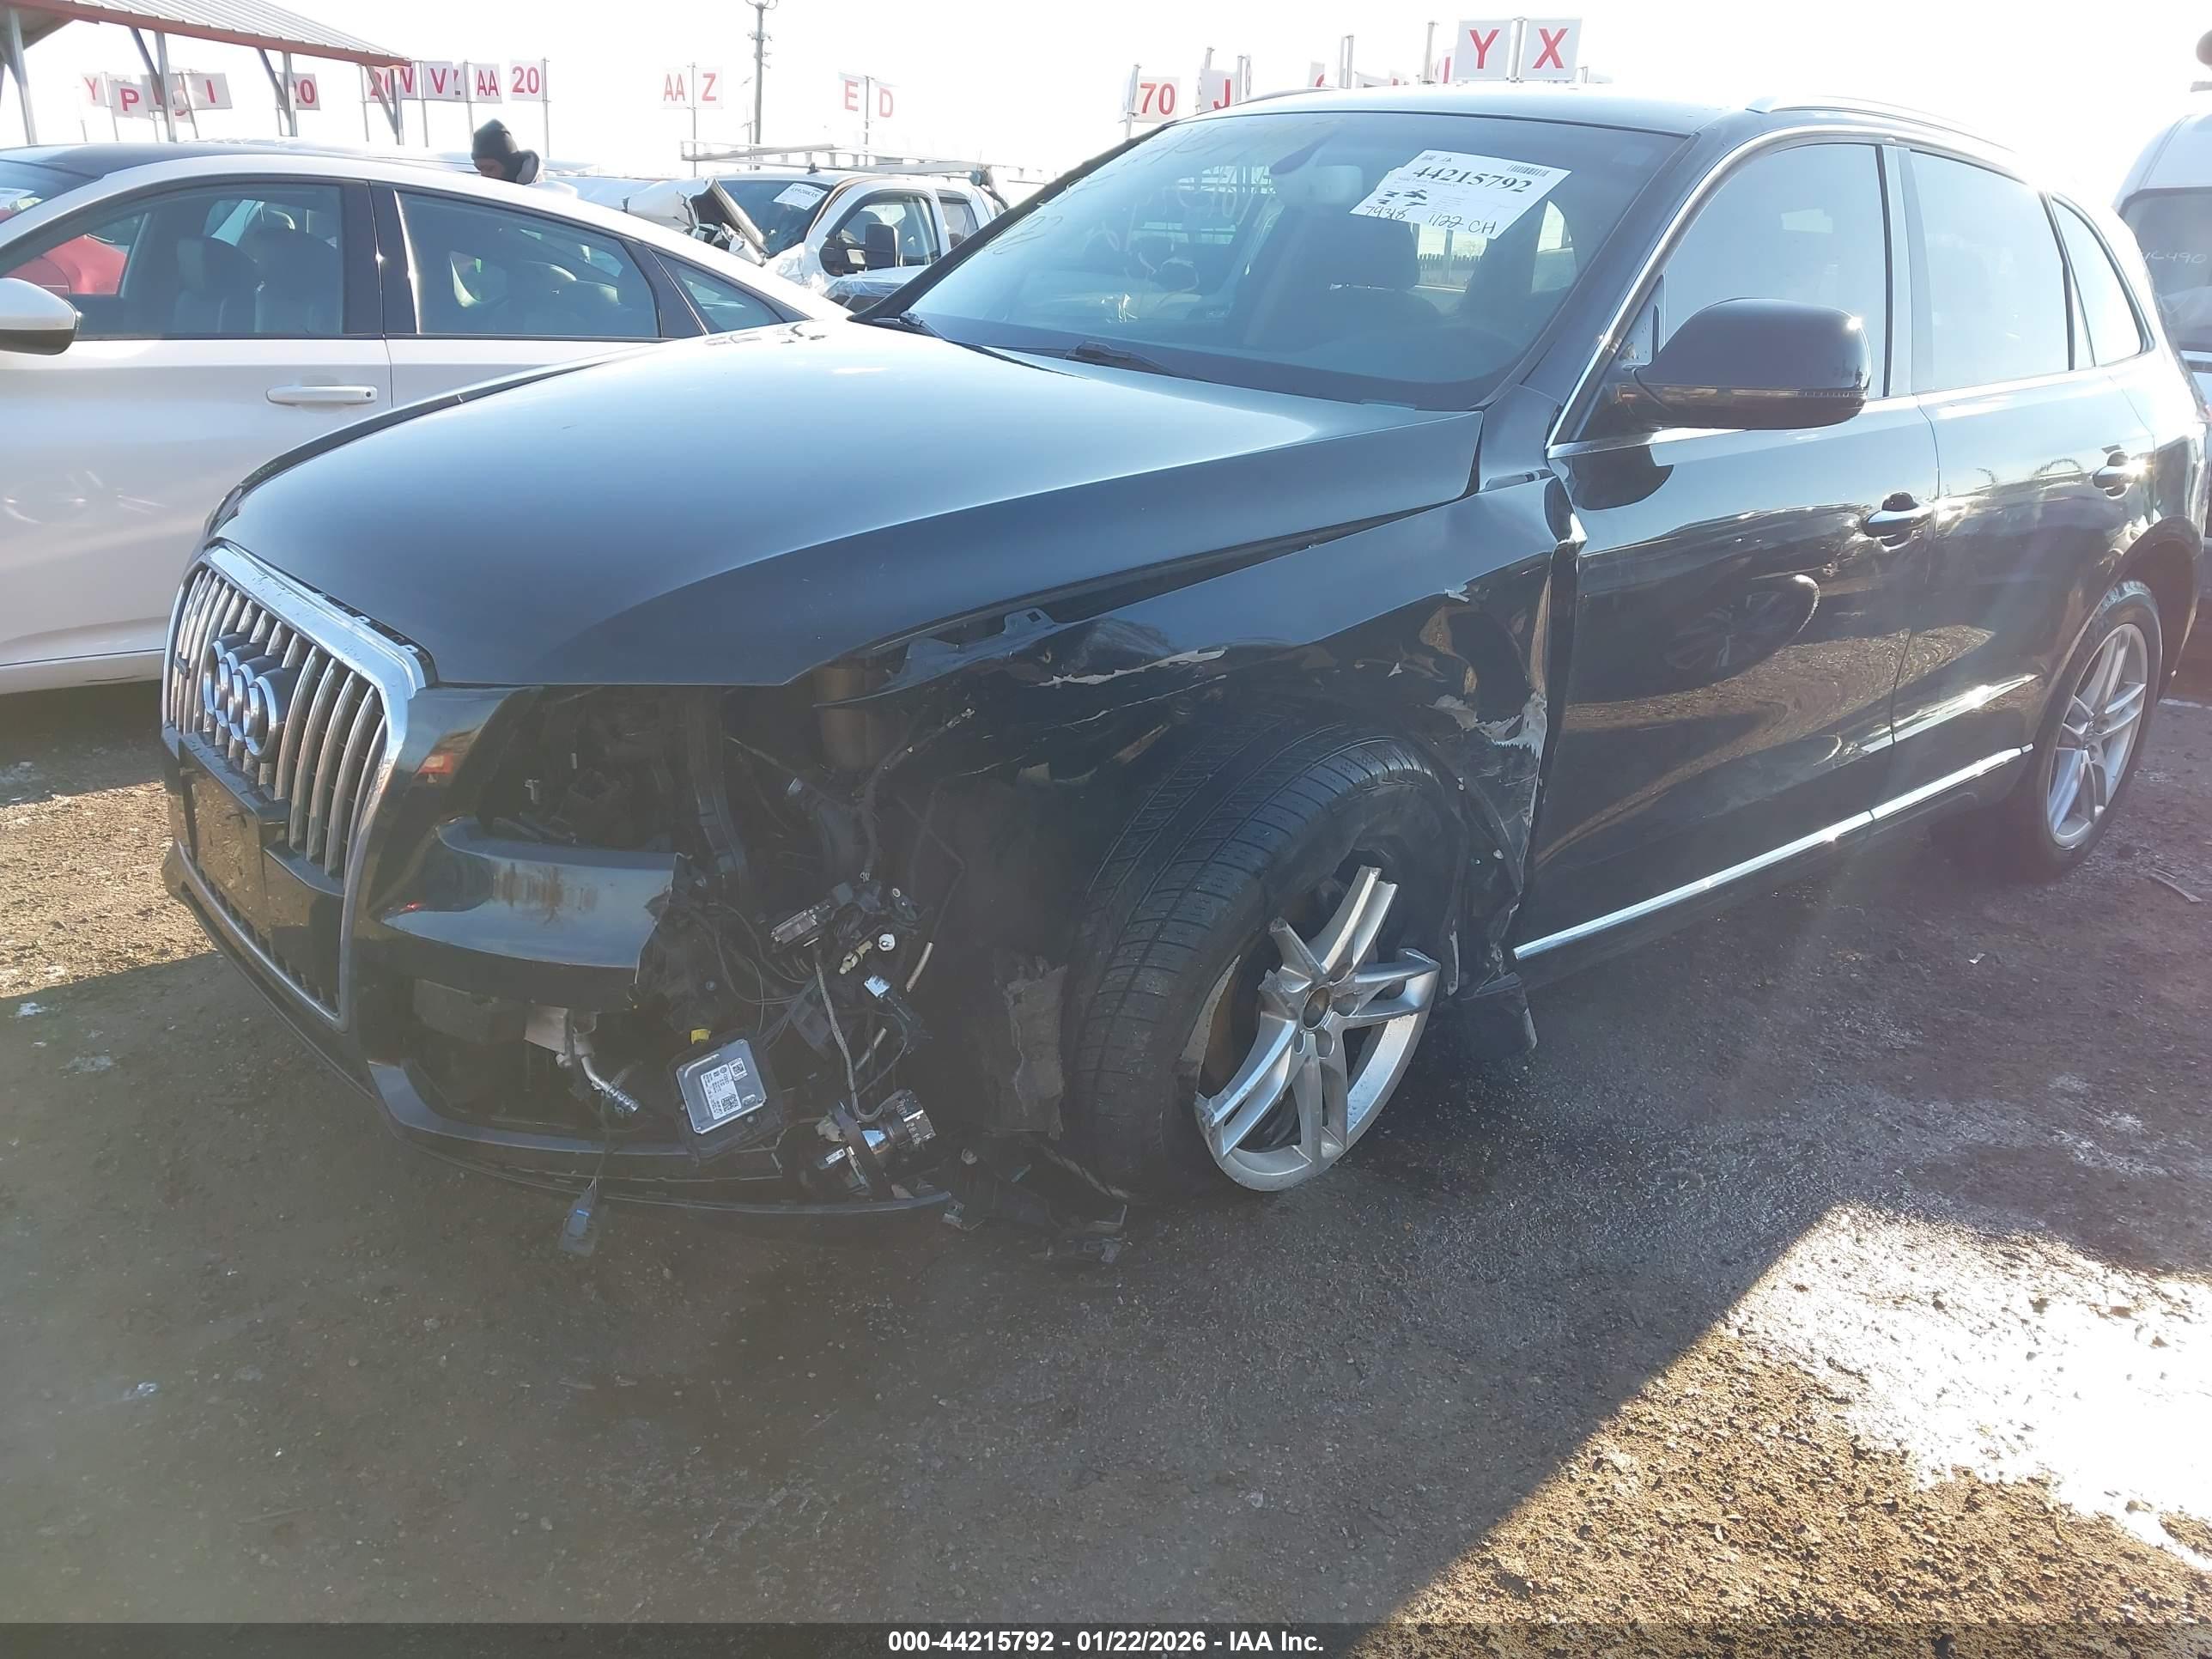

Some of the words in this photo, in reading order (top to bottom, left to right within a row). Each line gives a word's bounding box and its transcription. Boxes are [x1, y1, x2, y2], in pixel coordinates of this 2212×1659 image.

[1469, 29, 1500, 69] Y
[1533, 28, 1569, 69] X
[83, 76, 98, 101] Y
[429, 68, 447, 94] V
[477, 70, 499, 96] AA
[512, 66, 540, 94] 20
[663, 74, 685, 101] AA
[702, 73, 717, 101] Z
[1212, 78, 1231, 110] J
[120, 88, 140, 112] P
[844, 79, 859, 112] E
[879, 87, 894, 118] D
[1139, 82, 1176, 116] 70
[1413, 166, 1533, 193] 44215792
[1468, 220, 1497, 235] CH
